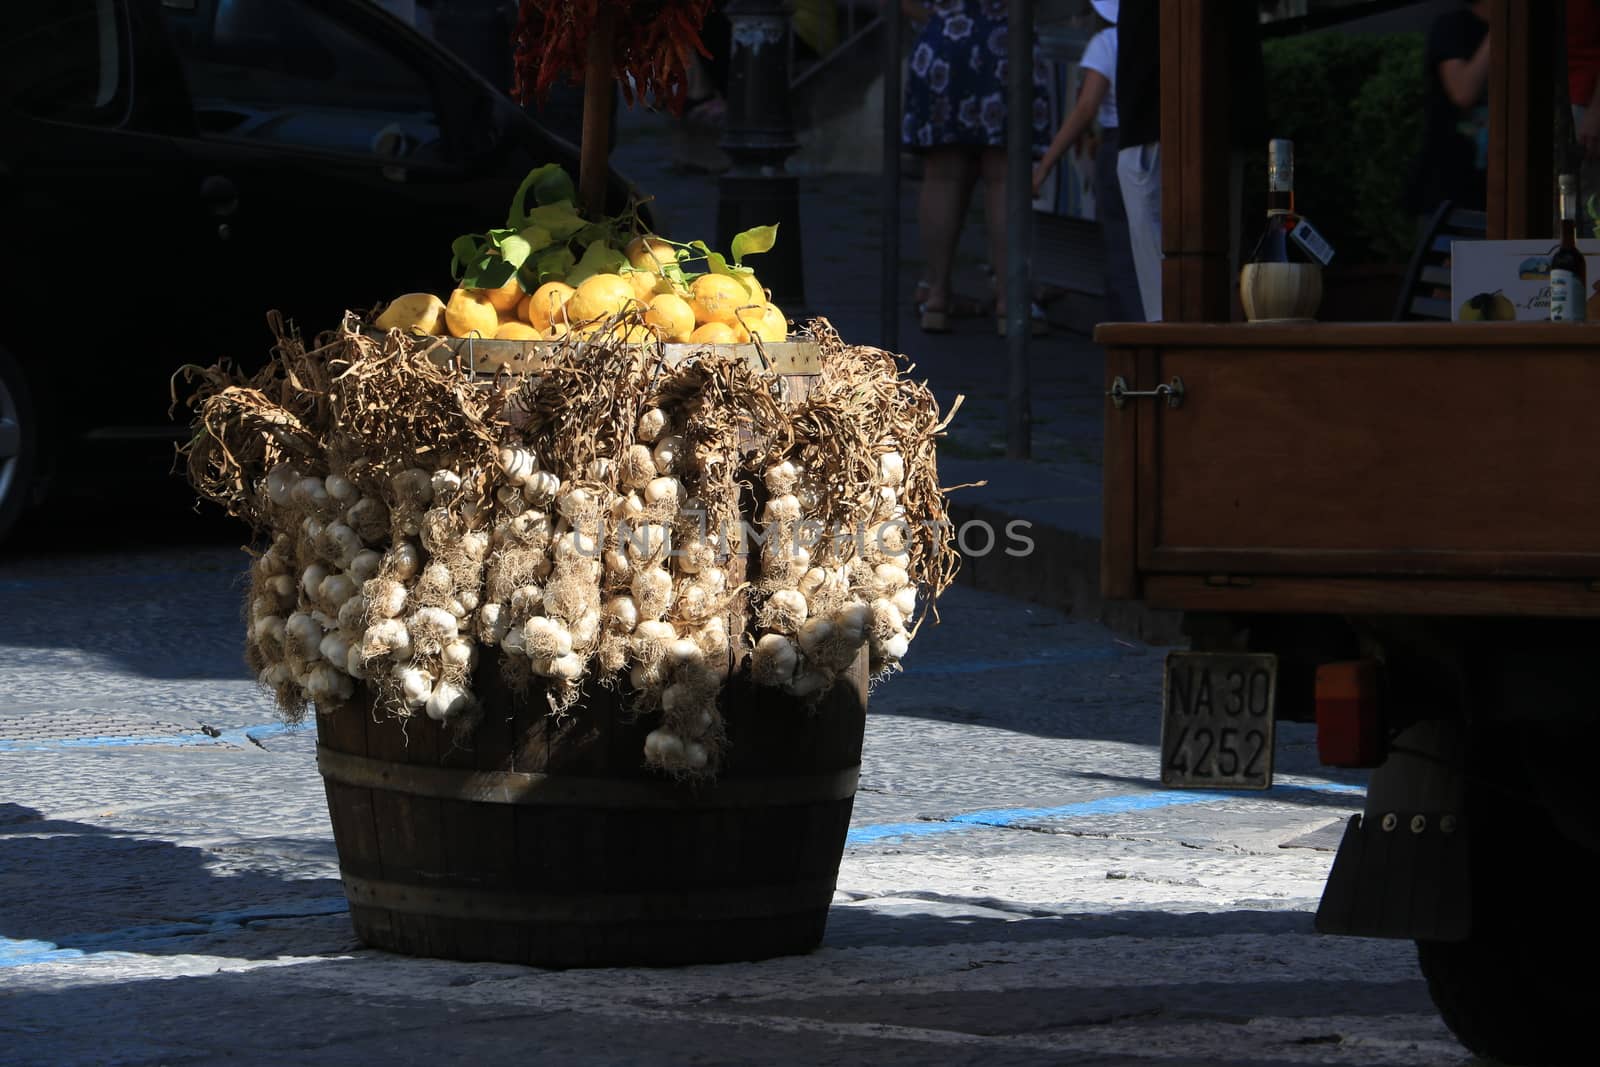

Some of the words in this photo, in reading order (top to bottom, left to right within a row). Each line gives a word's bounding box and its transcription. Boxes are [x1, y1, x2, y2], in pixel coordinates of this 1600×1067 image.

[1169, 667, 1213, 716] NA
[1225, 669, 1270, 717] 30
[1166, 726, 1265, 778] 4252
